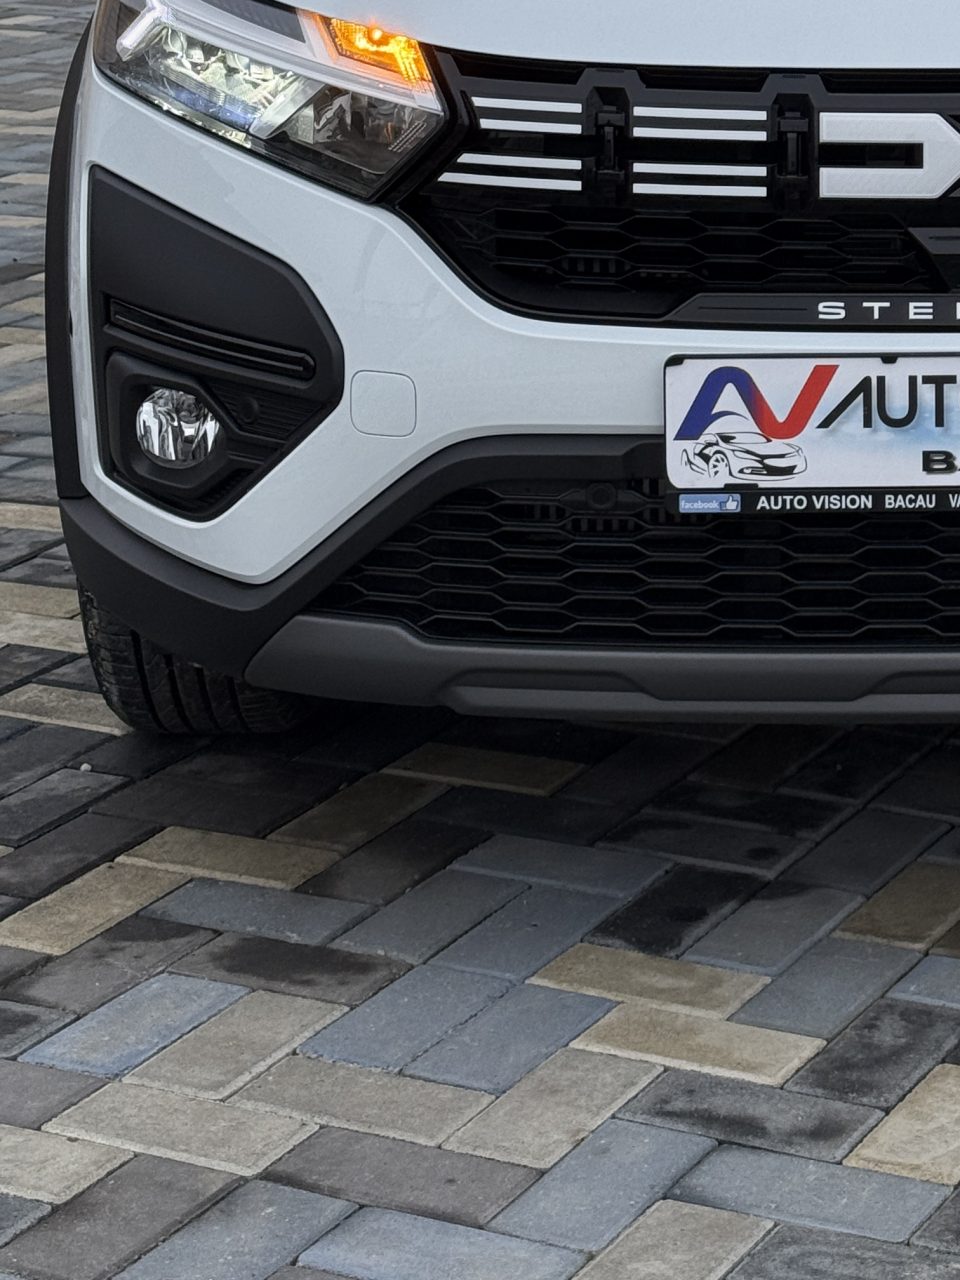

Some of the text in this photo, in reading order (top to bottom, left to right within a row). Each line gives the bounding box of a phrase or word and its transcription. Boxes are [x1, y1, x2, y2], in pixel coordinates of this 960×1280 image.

[681, 498, 720, 510] facebook
[756, 495, 808, 510] AUTO
[811, 494, 873, 510] VISION
[885, 494, 936, 509] BACAU
